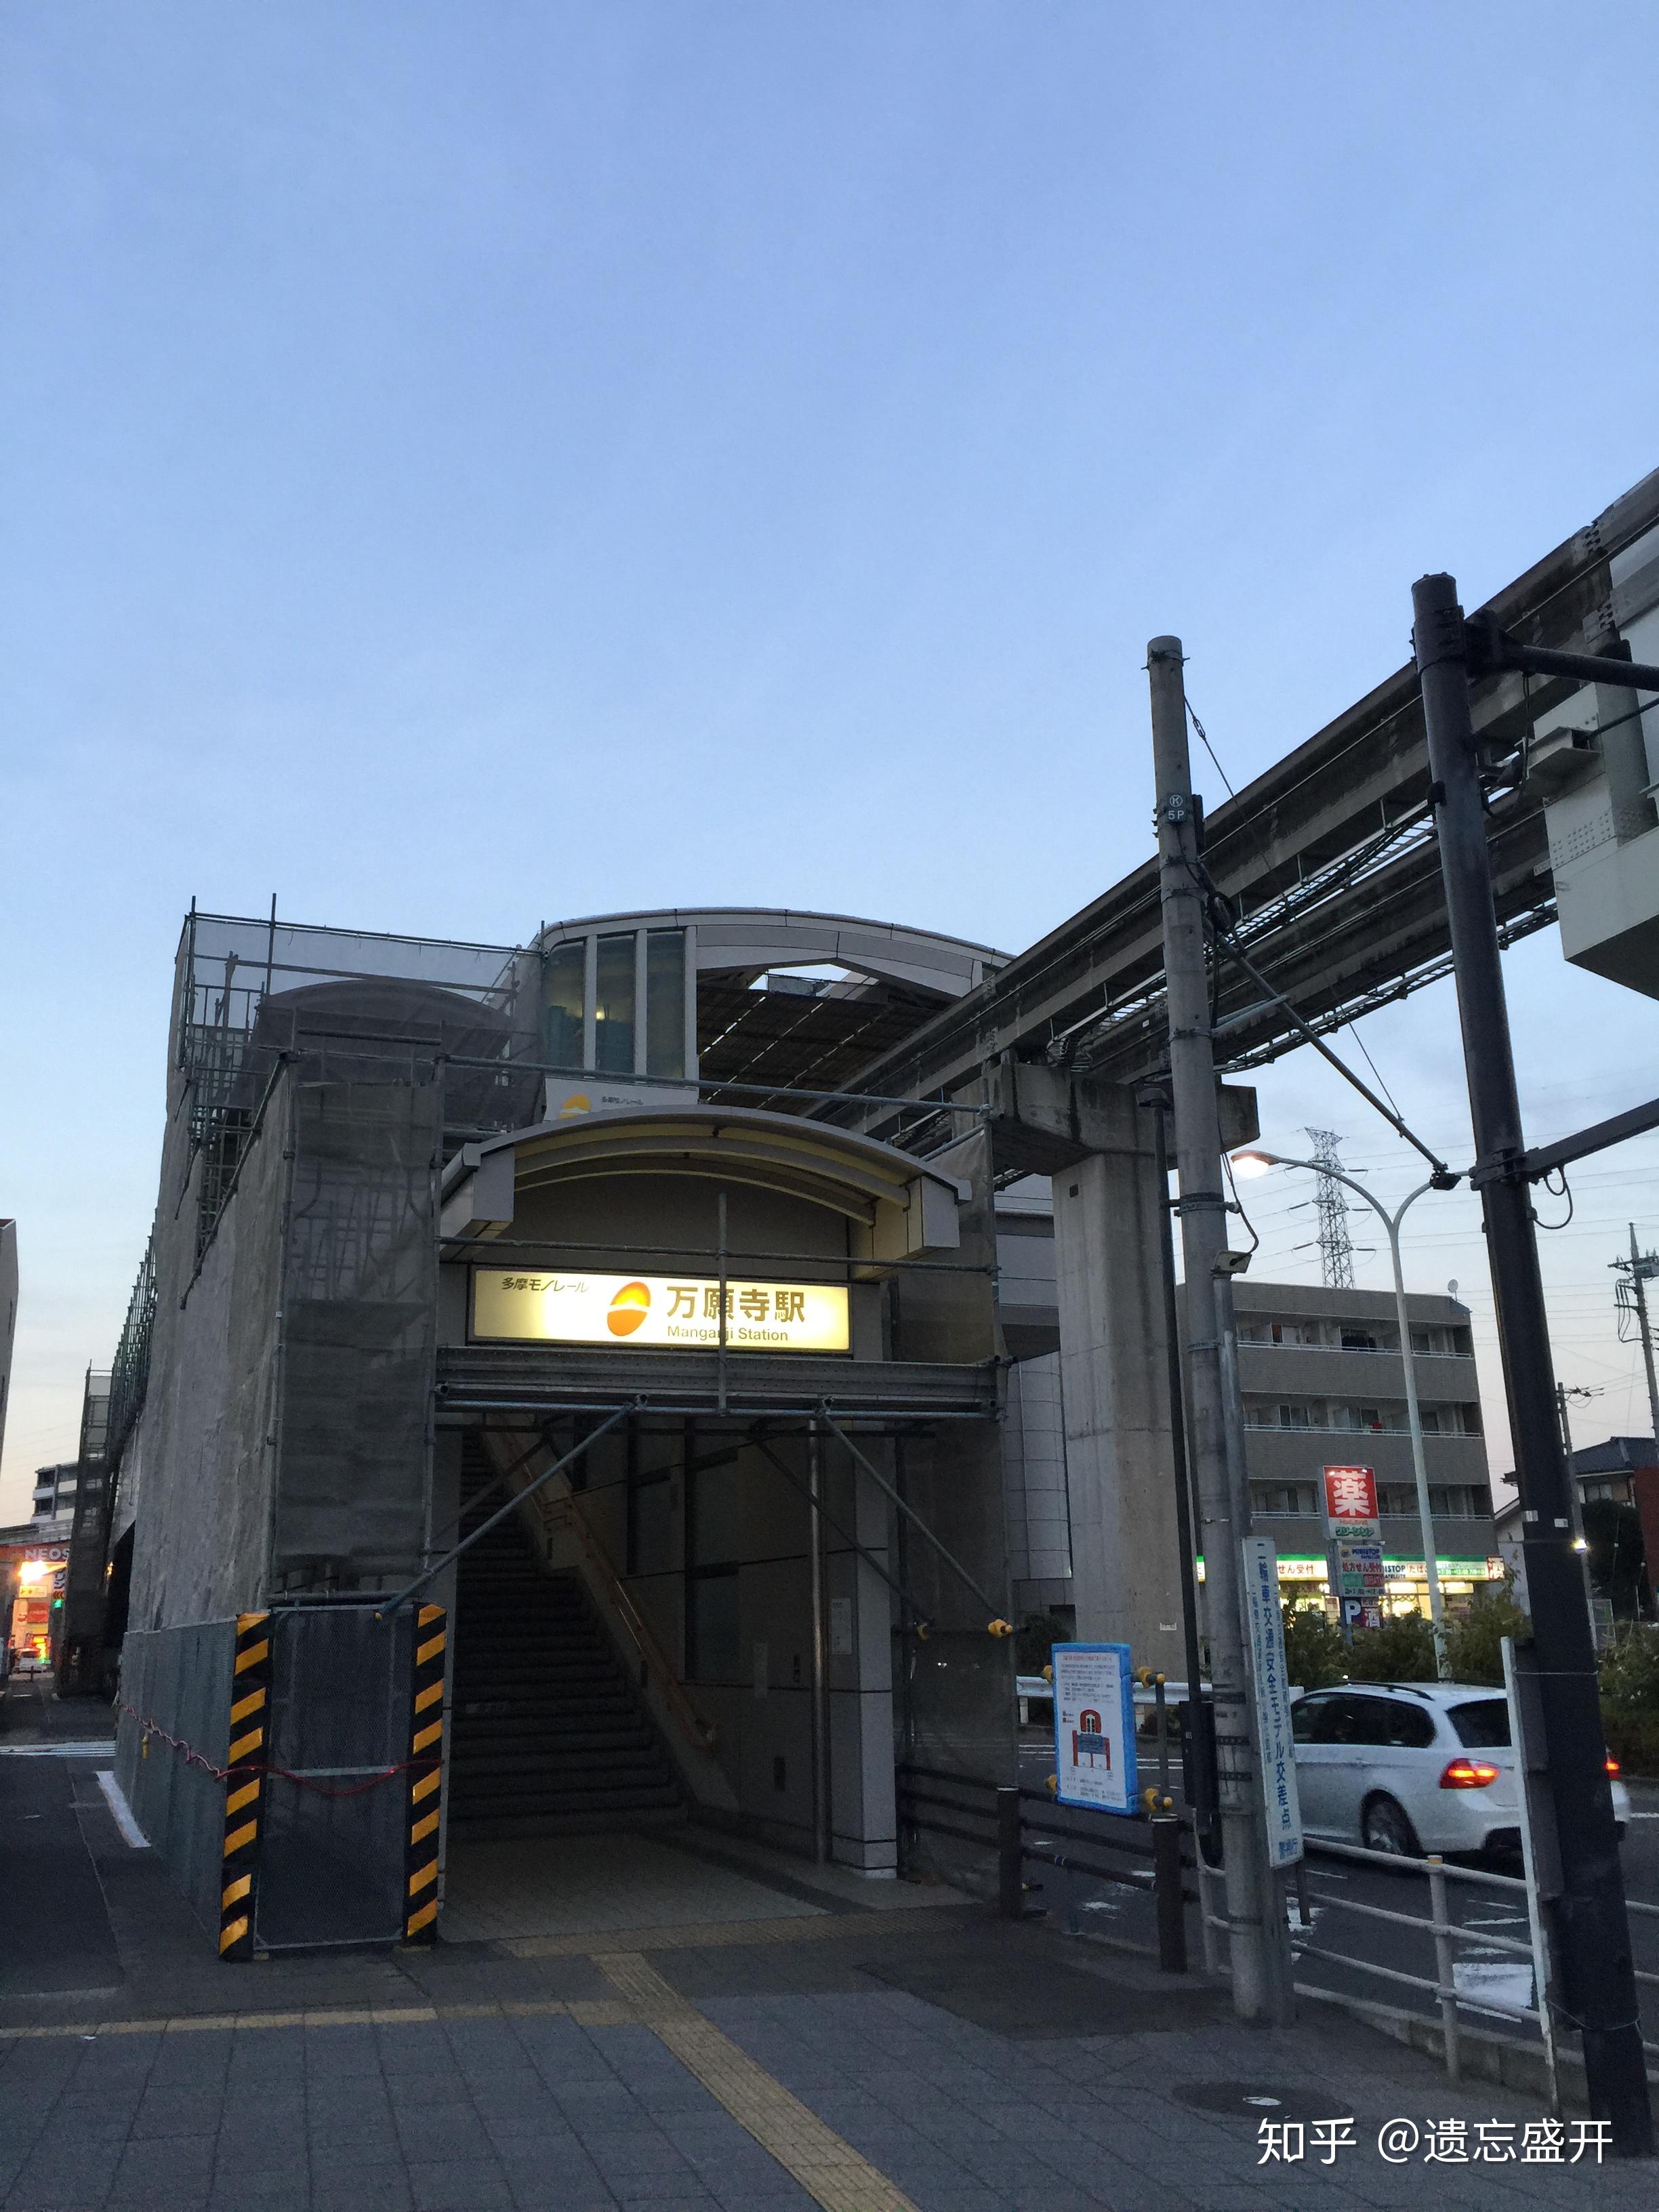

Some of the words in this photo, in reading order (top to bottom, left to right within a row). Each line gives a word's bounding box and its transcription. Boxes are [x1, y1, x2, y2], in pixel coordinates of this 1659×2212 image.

[501, 1277, 589, 1293] 多摩モノレール
[667, 1286, 805, 1323] 万願寺駅
[738, 1327, 788, 1341] Station
[1333, 1470, 1371, 1516] 薬
[1345, 1600, 1361, 1624] P
